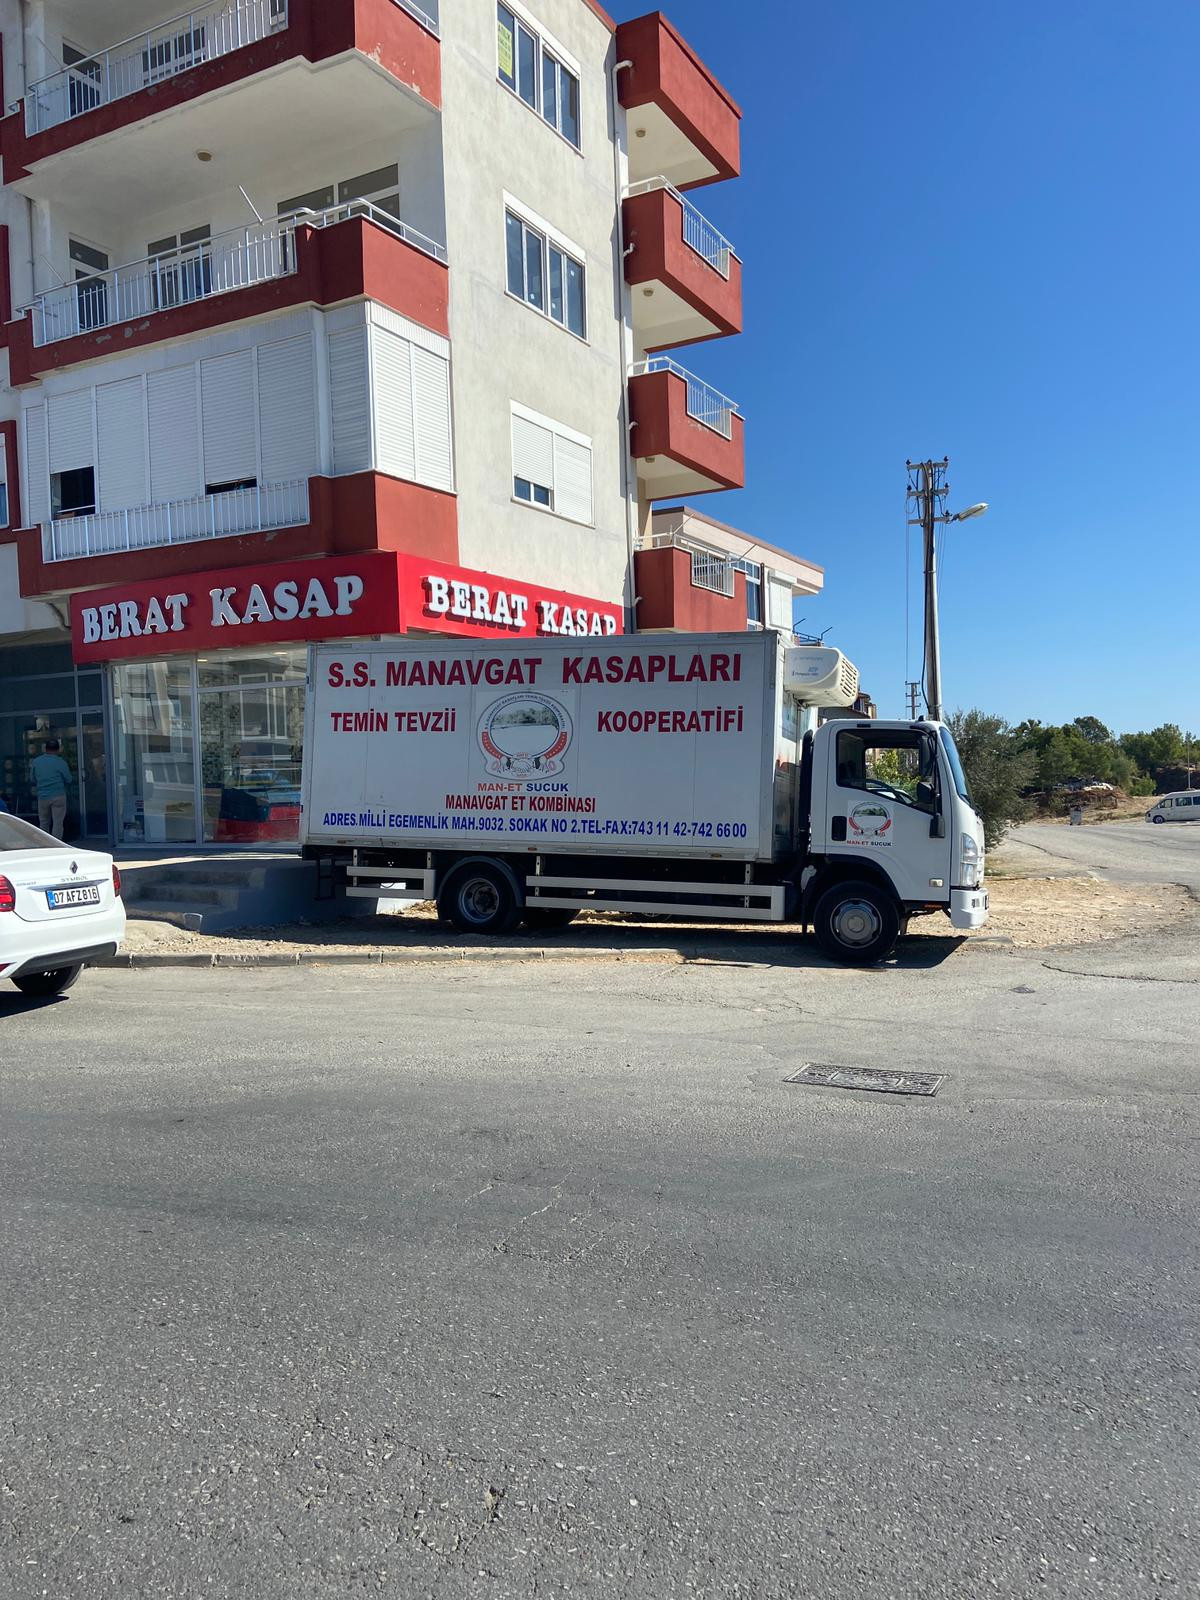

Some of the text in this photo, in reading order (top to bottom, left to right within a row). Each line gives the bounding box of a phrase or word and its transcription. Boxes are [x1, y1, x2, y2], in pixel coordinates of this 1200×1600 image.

[82, 575, 364, 644] BERAT KASAP
[427, 575, 617, 636] BERAT KASAP
[328, 653, 741, 687] S.S. MANAVGAT KASAPLARI
[330, 708, 388, 732] TEMİN
[395, 708, 456, 732] TEVZİİ
[597, 706, 743, 732] KOOPERATİFİ
[477, 783, 569, 792] MAN-ET SUCUK
[445, 794, 596, 813] MANAVGAT ET KOMBİNASI
[389, 812, 449, 830] EGEMENLİK
[509, 818, 548, 833] SOKAK
[551, 818, 567, 833] NO
